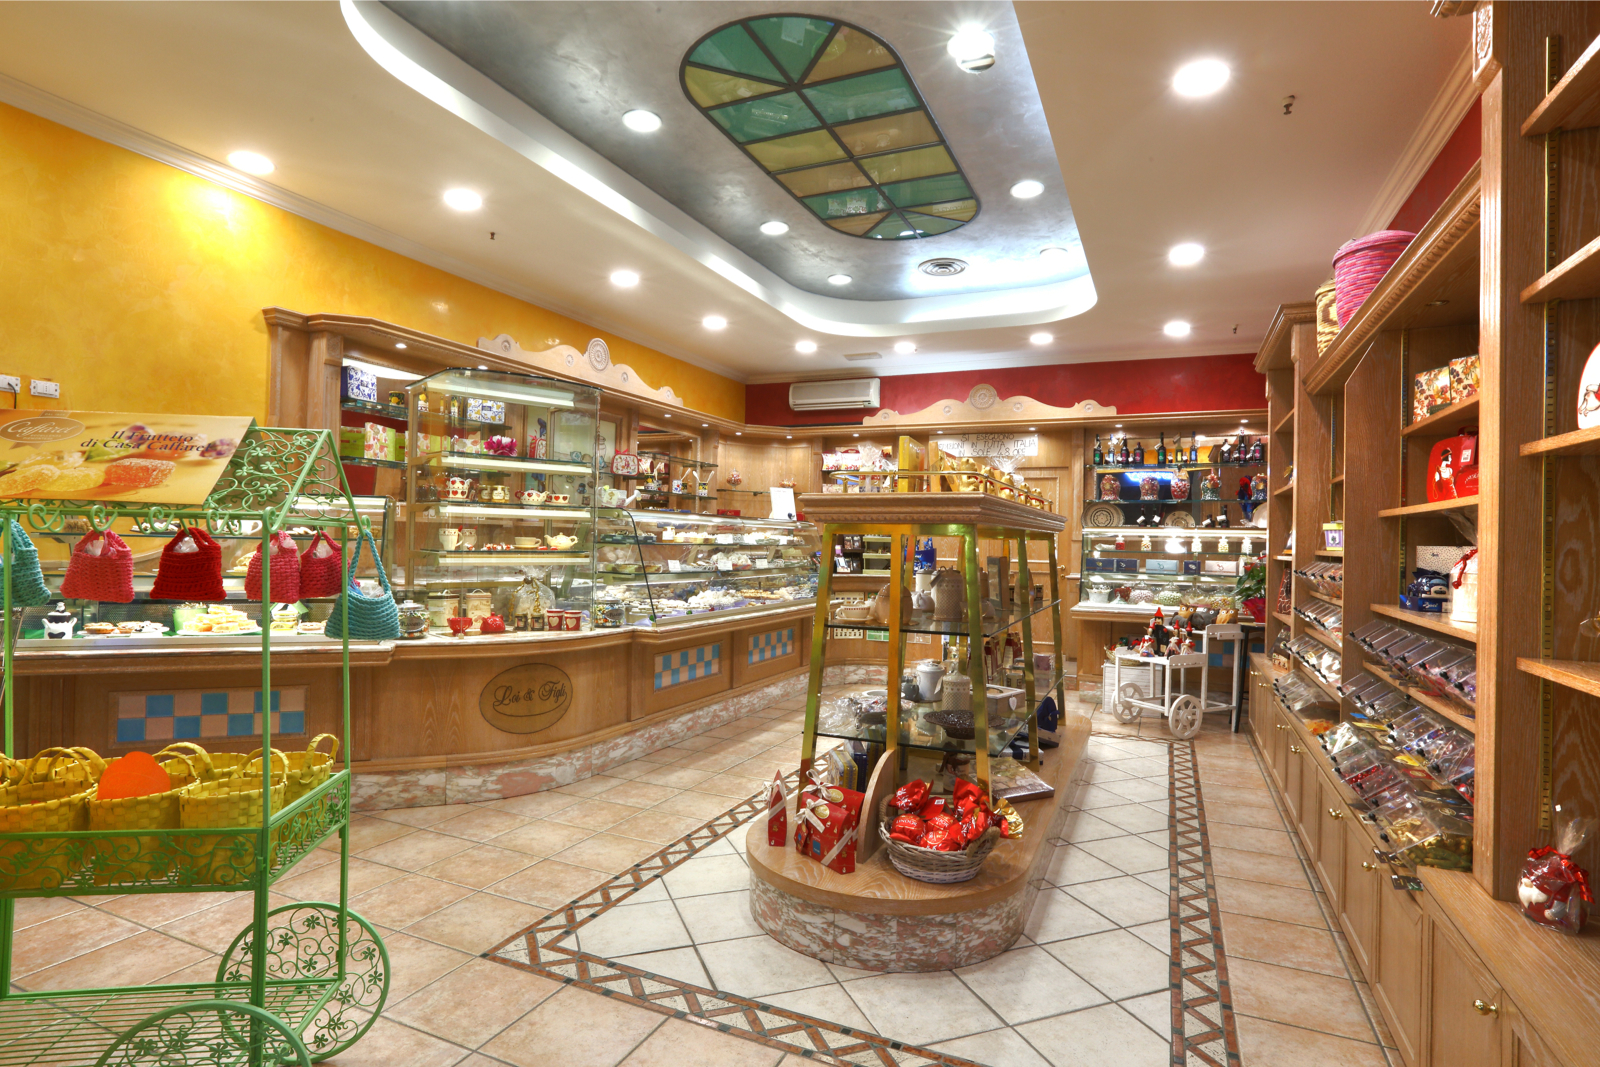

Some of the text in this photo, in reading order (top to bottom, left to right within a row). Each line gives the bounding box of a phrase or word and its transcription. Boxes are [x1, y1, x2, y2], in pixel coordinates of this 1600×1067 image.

[7, 421, 80, 437] Caffarel
[110, 430, 194, 442] Il Frutteto
[976, 433, 1015, 441] ESEGUONO
[80, 438, 213, 453] di Casa Caffarel
[971, 440, 978, 449] IN
[983, 440, 1006, 449] TUTTA
[1013, 438, 1037, 448] ITALIA
[971, 447, 991, 456] SOLE
[523, 687, 536, 702] &
[538, 680, 567, 704] Figli
